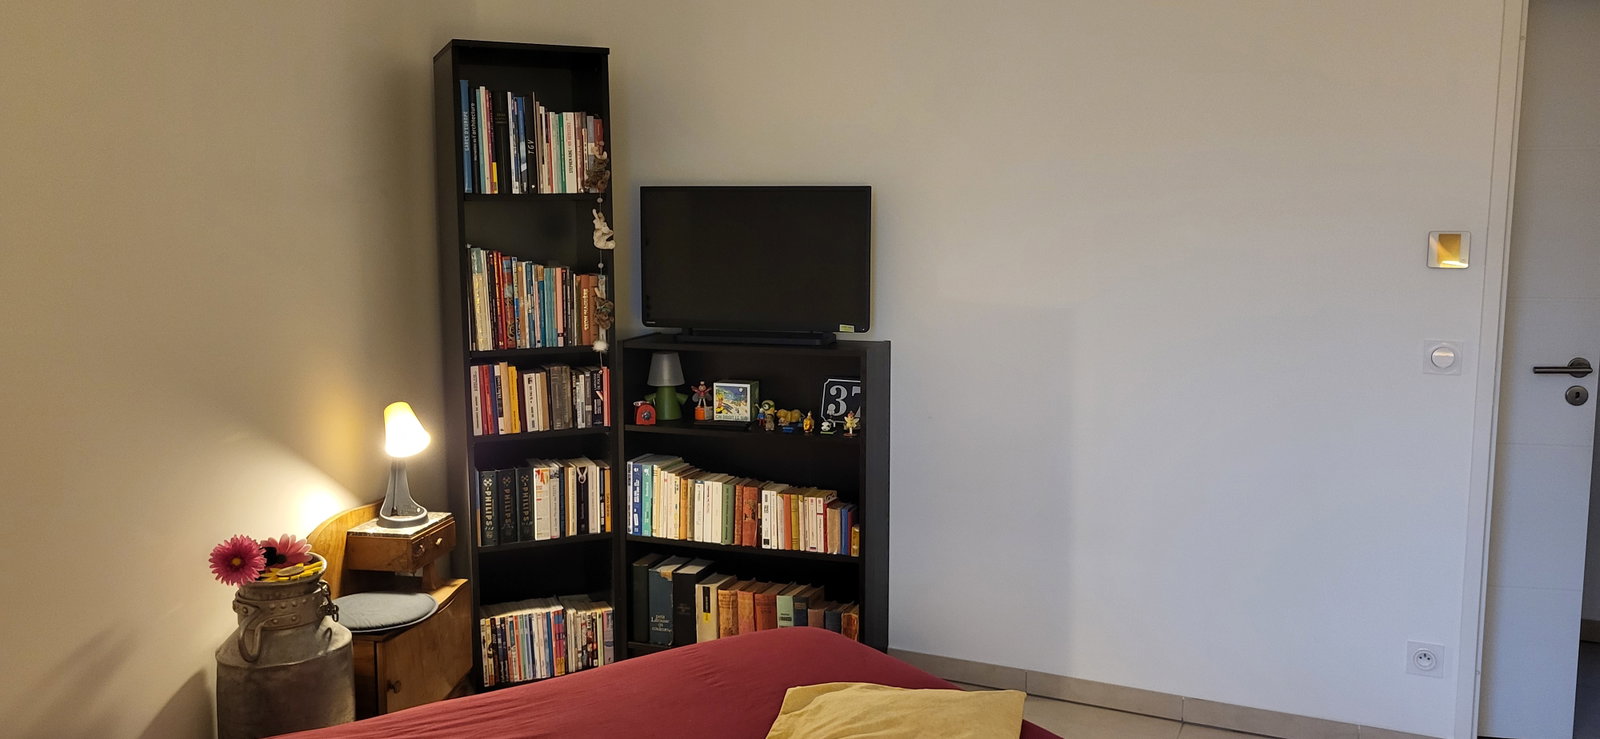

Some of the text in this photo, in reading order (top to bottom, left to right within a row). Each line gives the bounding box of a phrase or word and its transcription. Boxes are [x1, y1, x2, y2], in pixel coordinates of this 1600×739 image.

[527, 139, 535, 155] TGV
[485, 490, 493, 526] PHILIPS
[504, 488, 512, 524] PHILIPS
